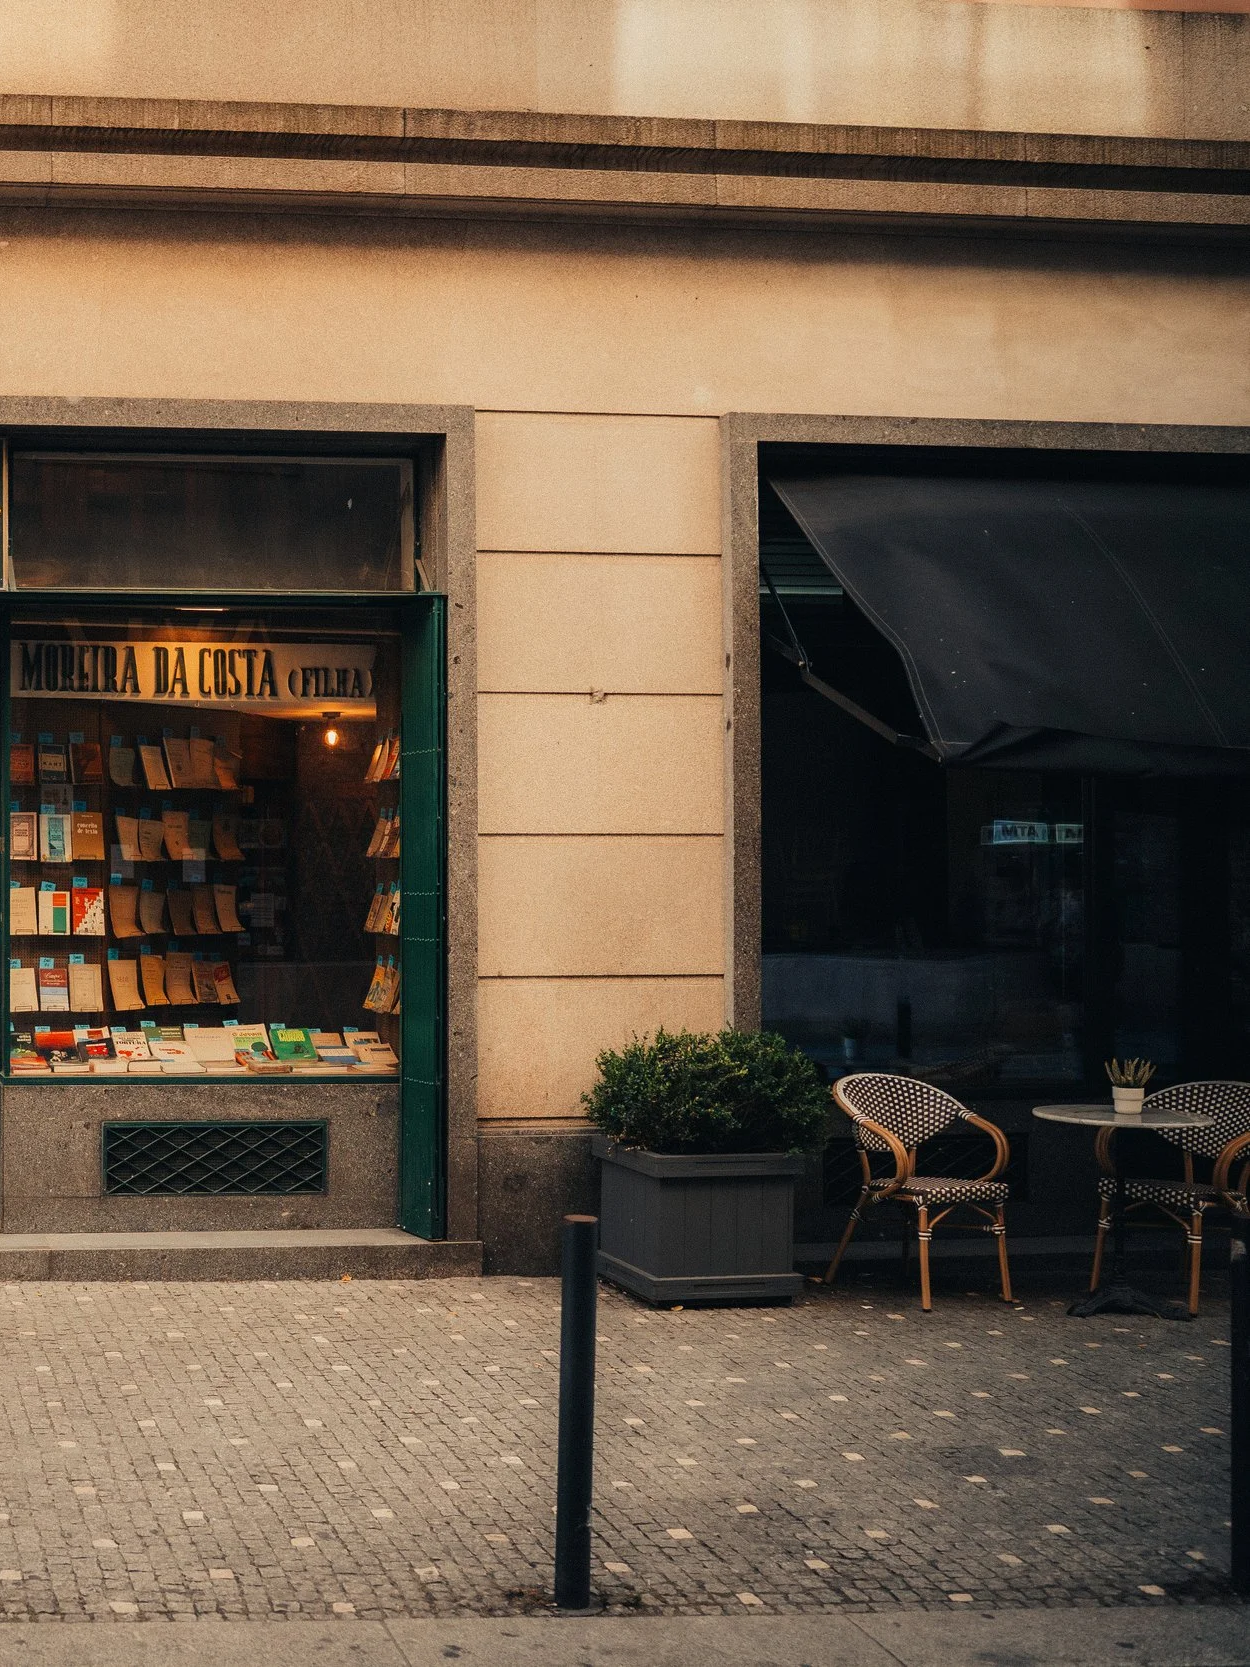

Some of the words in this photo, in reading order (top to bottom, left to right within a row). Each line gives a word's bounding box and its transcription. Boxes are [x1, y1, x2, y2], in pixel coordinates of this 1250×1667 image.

[18, 642, 142, 694] MOREIRA
[153, 646, 190, 695] DA
[198, 647, 279, 698] COSTA
